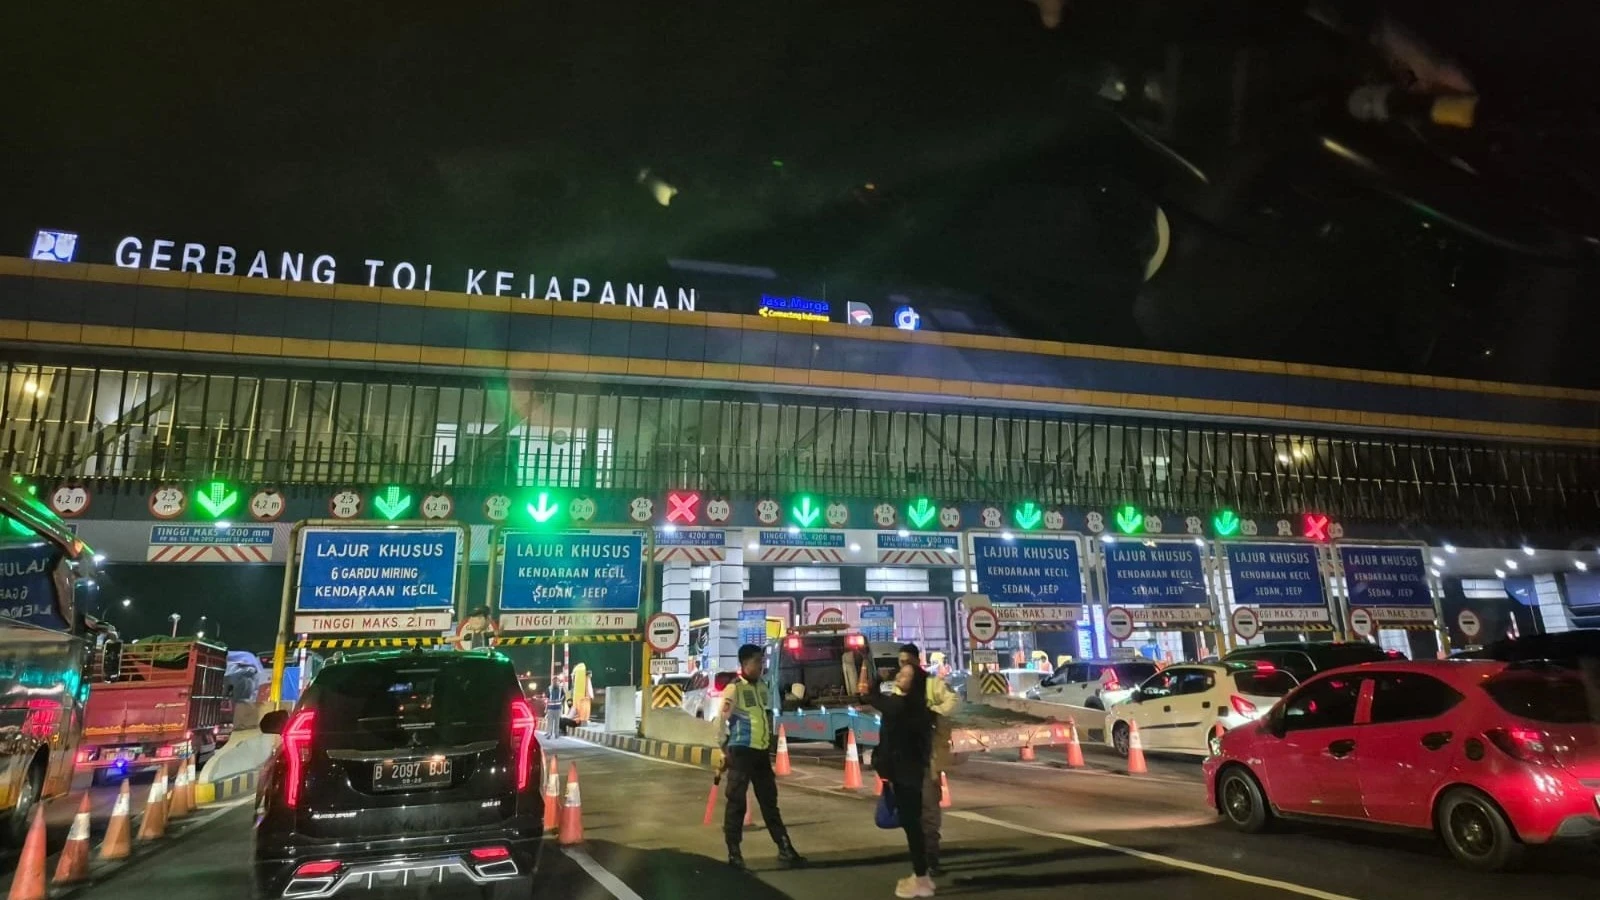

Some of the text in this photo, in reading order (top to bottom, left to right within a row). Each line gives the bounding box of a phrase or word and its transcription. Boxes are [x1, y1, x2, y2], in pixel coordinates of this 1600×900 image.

[115, 236, 336, 285] GERBANG
[466, 268, 696, 312] KEJAPANAN
[56, 495, 84, 504] 4,2 m
[162, 491, 177, 501] 2,5
[340, 496, 354, 505] 2,5
[254, 500, 280, 510] 4,2 m
[425, 502, 448, 511] 4,2 m
[636, 500, 648, 510] 2,5
[708, 506, 720, 515] 4,2
[763, 502, 773, 511] 2,5
[157, 527, 190, 537] TINGGI
[226, 529, 249, 537] 4200
[252, 529, 270, 537] mm
[317, 543, 443, 557] LAJUR KHUSUS
[517, 544, 630, 558] LAJUR KHUSUS
[983, 545, 1070, 560] LAJUR KHUSUS
[1112, 549, 1193, 562] LAJUR KHUSUS
[1235, 552, 1310, 564] LAJUR KHUSUS
[1349, 553, 1418, 566] LAJUR KHUSUS
[331, 567, 418, 580] 6 GARDU MIRING
[518, 567, 625, 578] KENDARAAN KECIL
[987, 566, 1069, 578] KENDARAAN KECIL
[1117, 569, 1193, 579] KENDARAAN KECIL
[1240, 570, 1311, 580] KENDARAAN KECIL
[1354, 572, 1398, 581] KENDARAAN
[315, 584, 438, 597] KENDARAAN KECIL
[582, 587, 608, 598] JEEP
[1039, 584, 1059, 594] JEEP
[1131, 585, 1184, 596] SEDAN, JEEP
[1255, 587, 1302, 596] SEDAN, JEEP
[1398, 588, 1414, 597] JEEP
[312, 618, 355, 629] TINGGI
[362, 617, 401, 628] MAKS.
[425, 618, 436, 627] m
[515, 616, 552, 626] TINGGI
[596, 615, 609, 626] 2,1
[614, 616, 624, 625] m
[375, 761, 450, 779] B 2097 BJC
